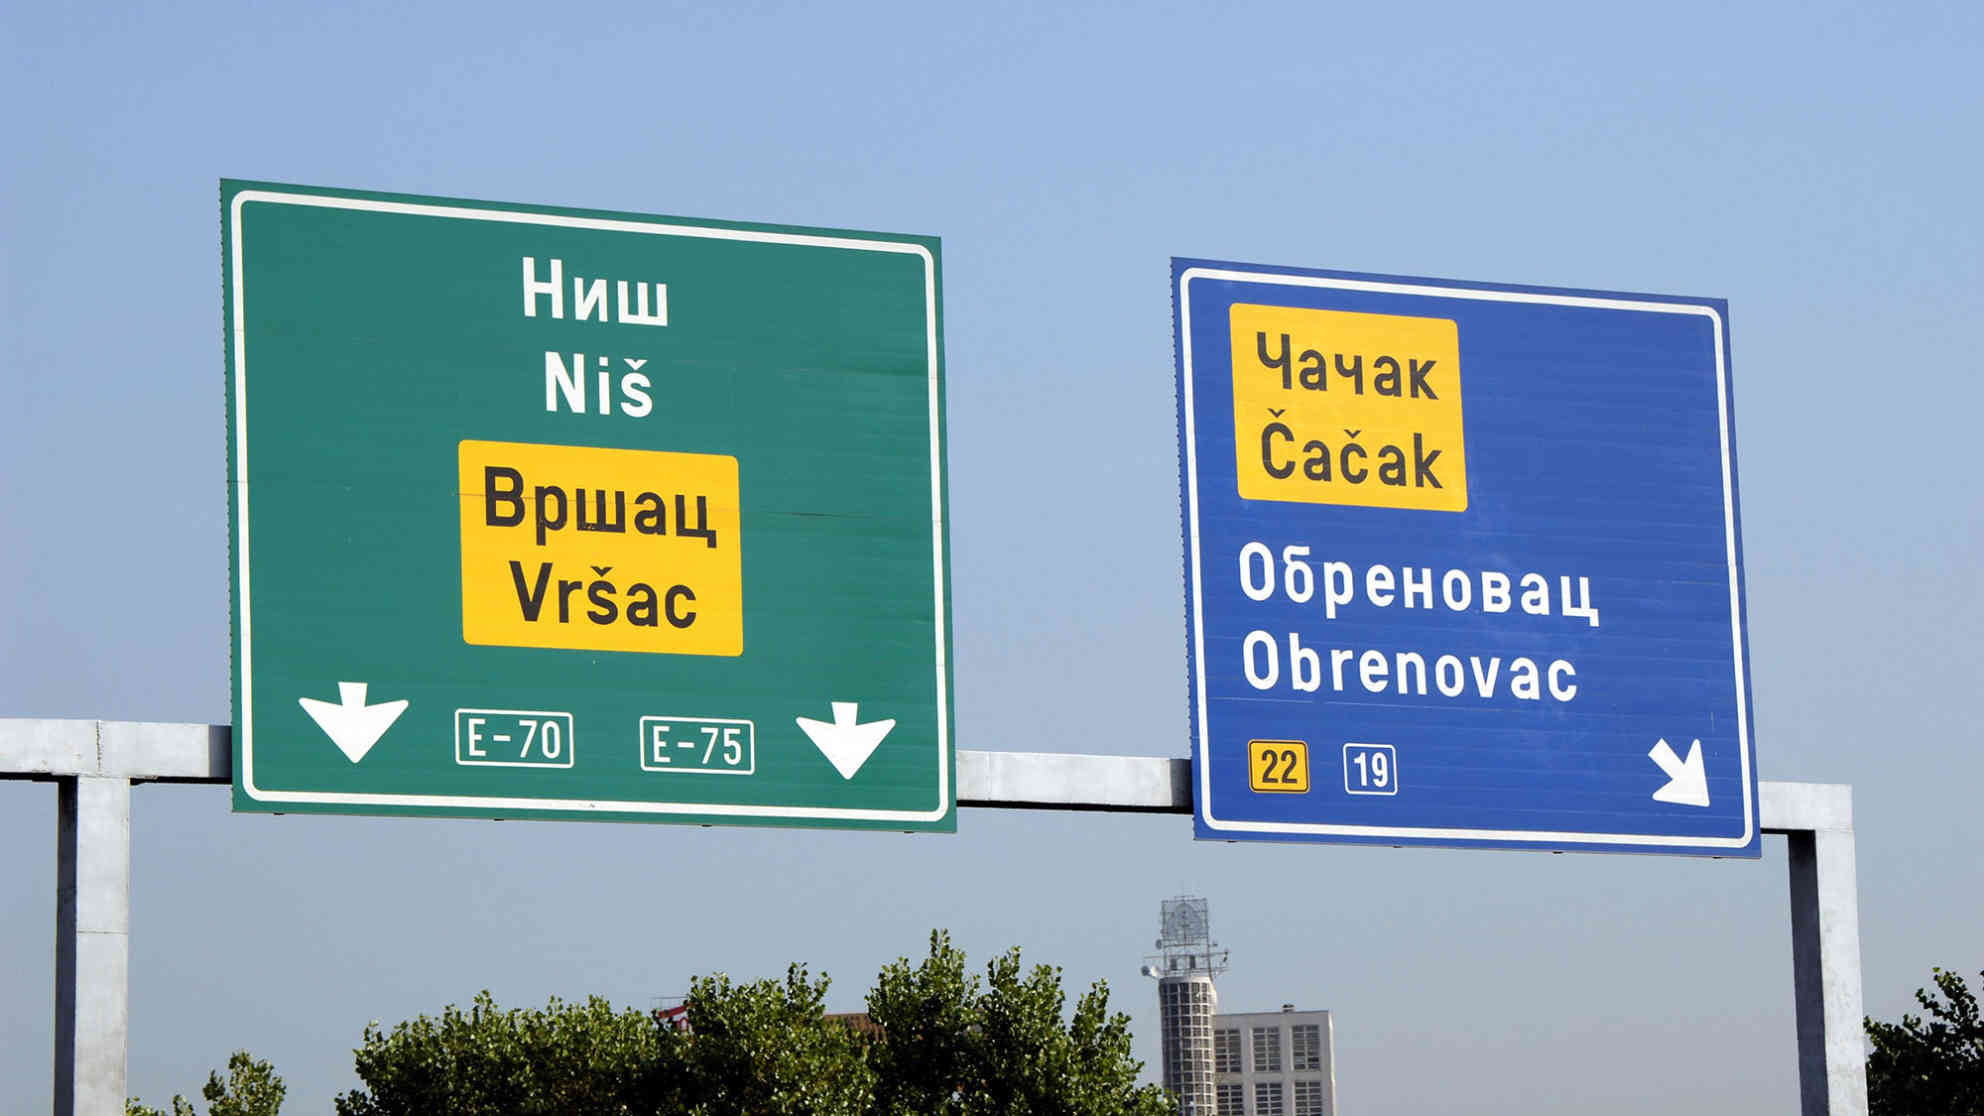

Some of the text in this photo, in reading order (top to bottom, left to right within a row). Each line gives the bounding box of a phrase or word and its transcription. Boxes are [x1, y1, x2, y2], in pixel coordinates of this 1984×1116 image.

[522, 256, 668, 327] Ниш
[545, 351, 653, 418] Niš
[1257, 331, 1438, 400] Чачак
[1261, 408, 1443, 489] Čačak
[484, 465, 717, 549] Вршац
[509, 560, 697, 629] Vršac
[1239, 541, 1600, 627] Обреновац
[1243, 630, 1577, 702] Obrenovac
[468, 718, 561, 759] E-70
[653, 725, 742, 765] E-75
[1261, 749, 1298, 784] 22
[1354, 752, 1388, 788] 19
